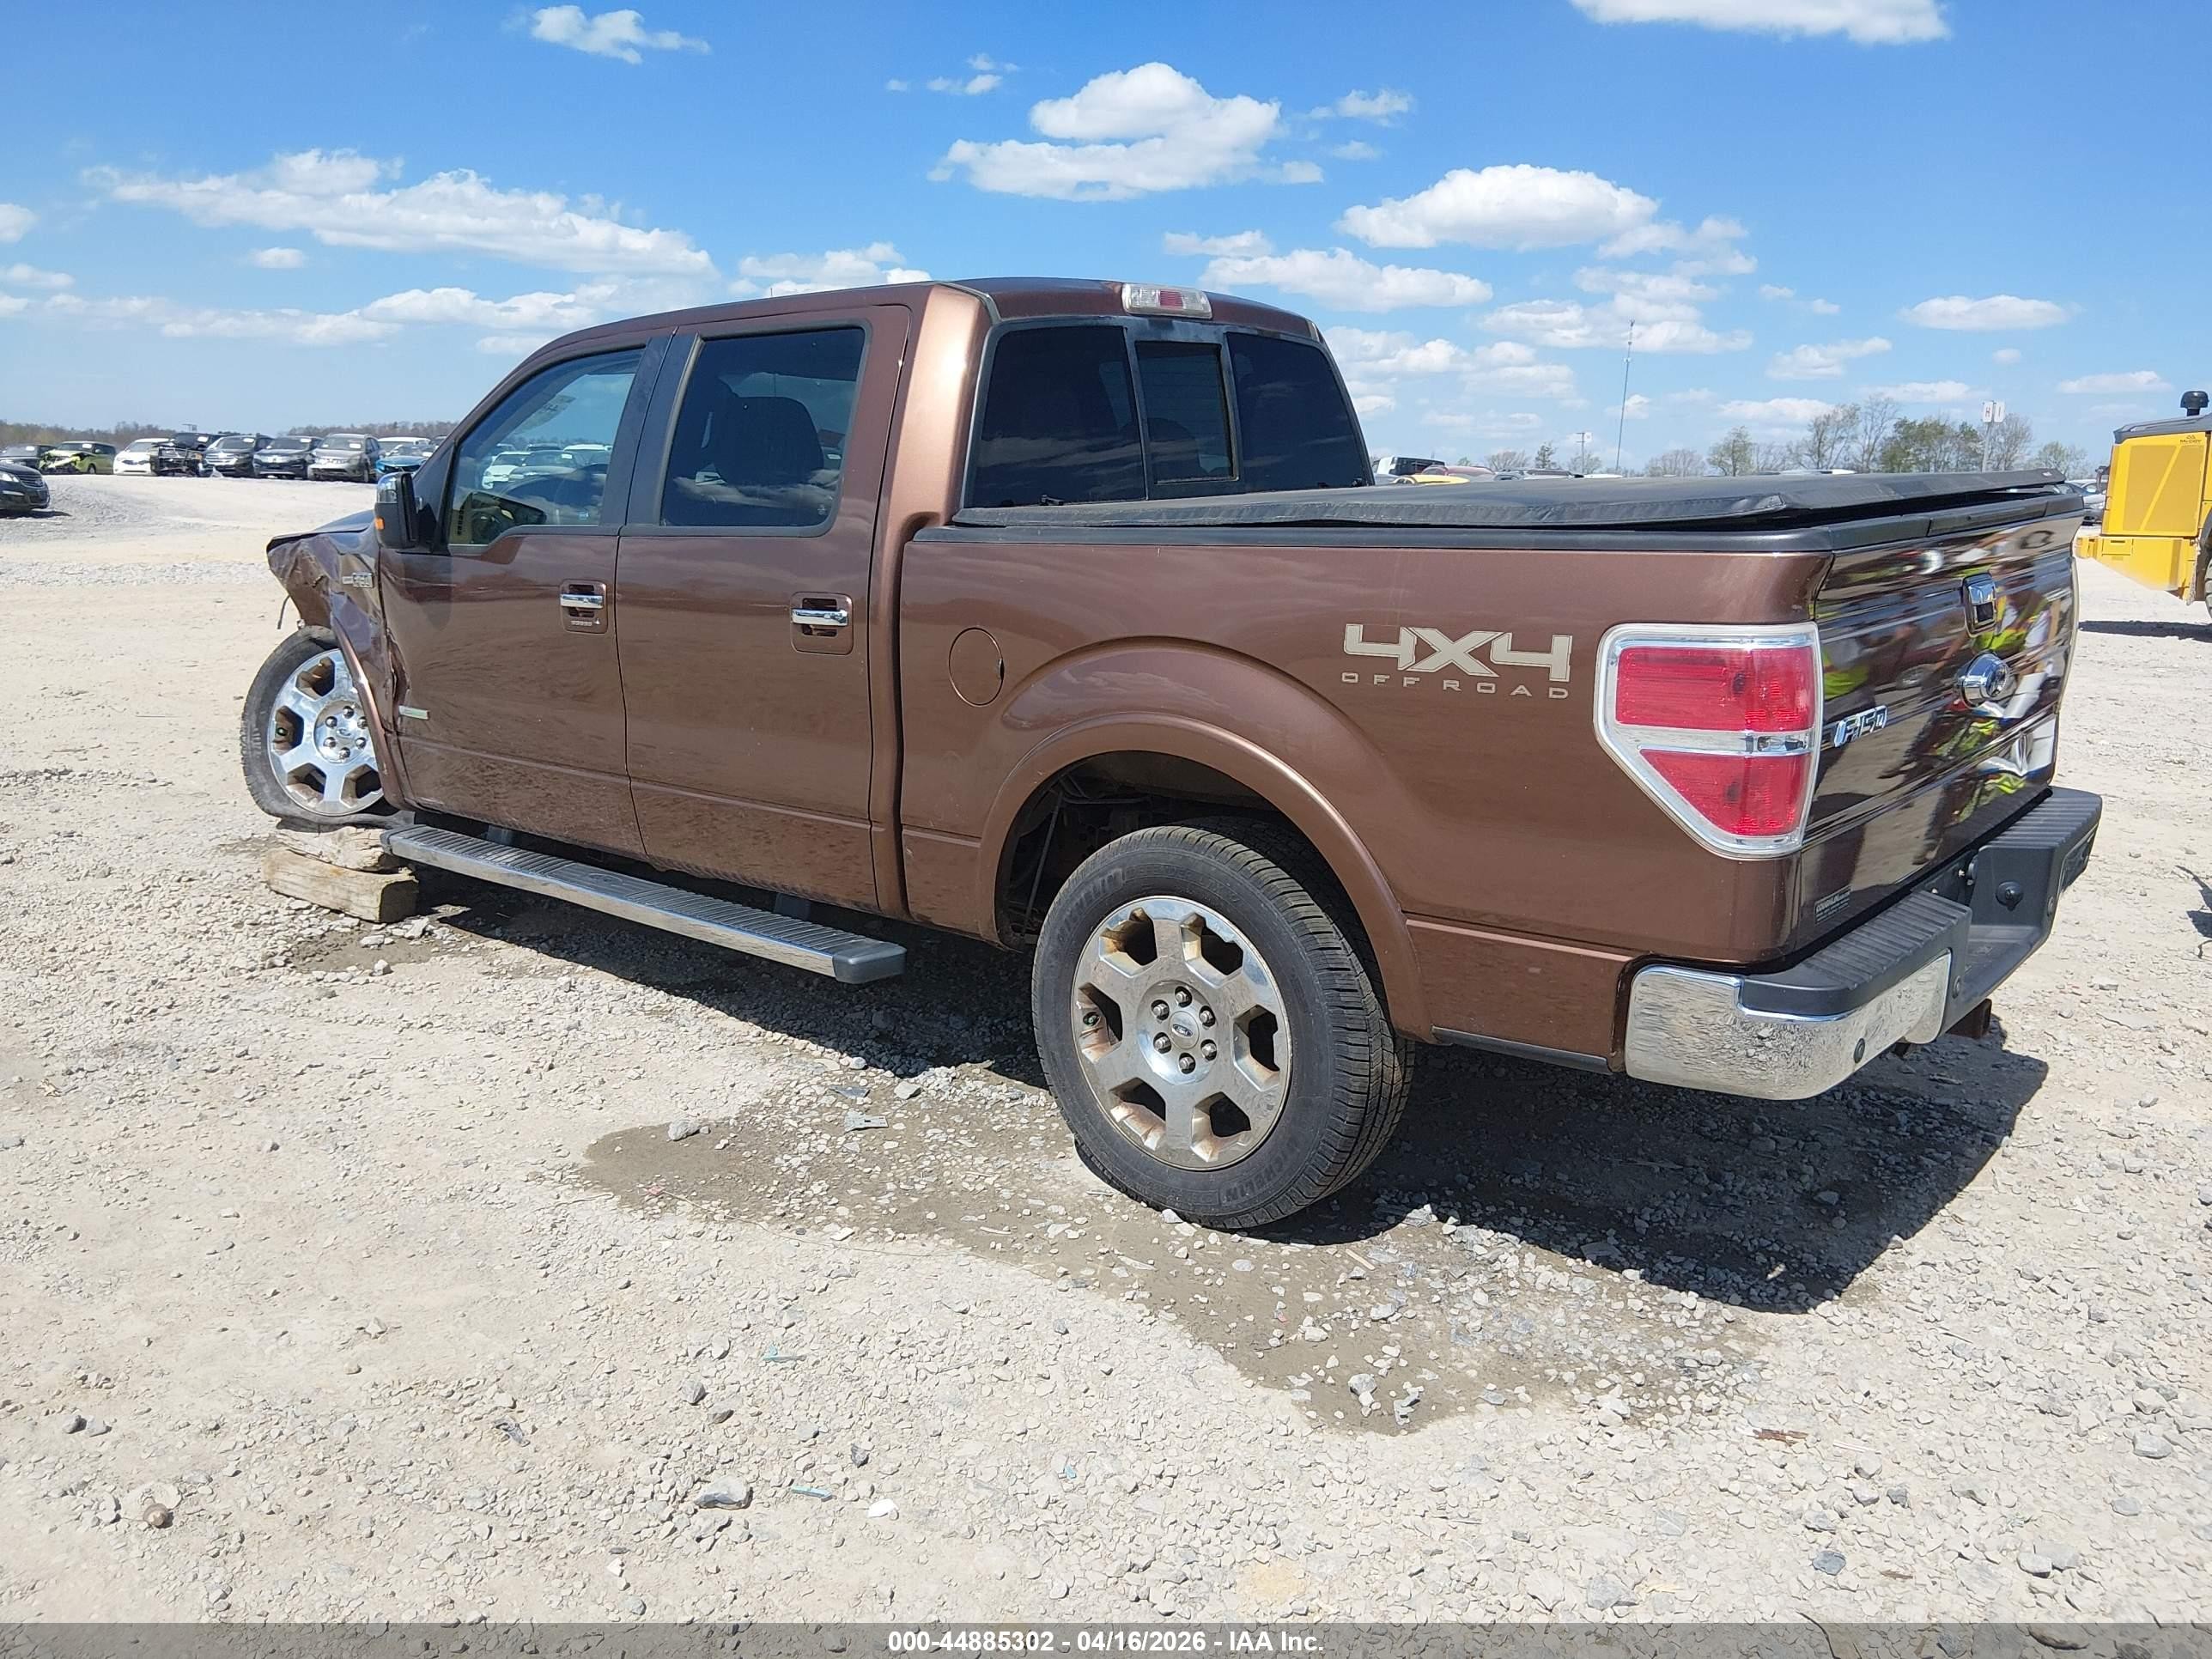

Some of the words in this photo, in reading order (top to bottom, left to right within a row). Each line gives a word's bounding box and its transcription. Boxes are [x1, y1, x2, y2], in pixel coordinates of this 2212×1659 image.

[1343, 623, 1573, 683] 4X4
[1341, 672, 1420, 688] OFF
[1443, 679, 1570, 700] ROAD
